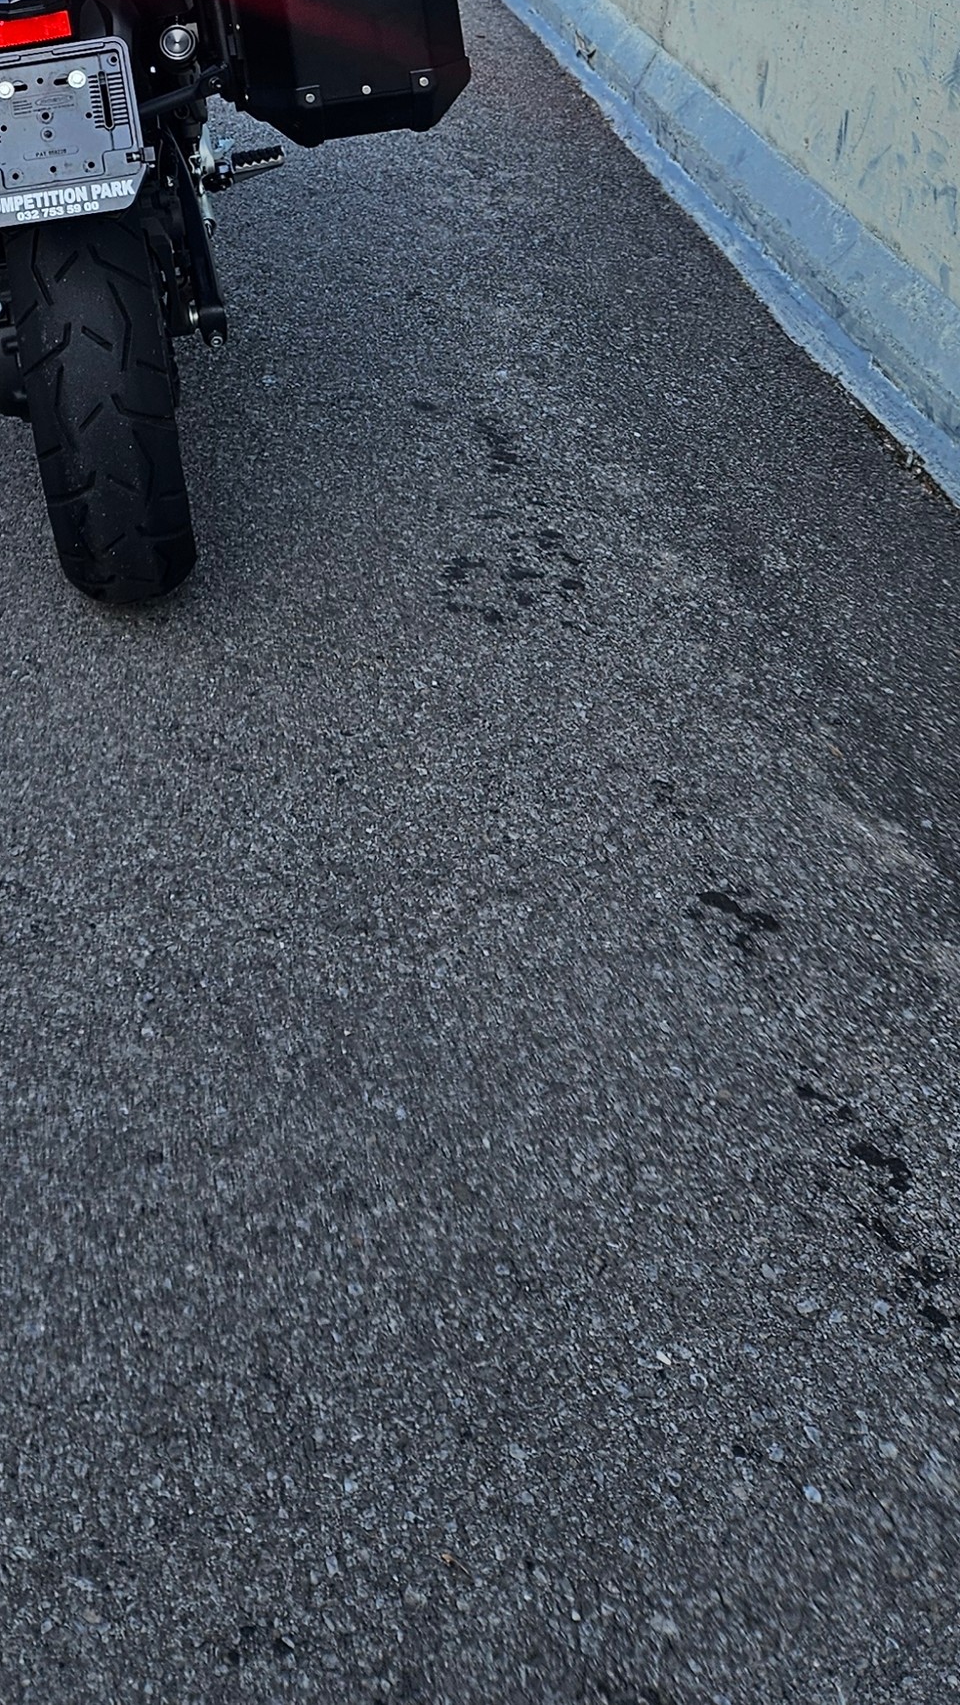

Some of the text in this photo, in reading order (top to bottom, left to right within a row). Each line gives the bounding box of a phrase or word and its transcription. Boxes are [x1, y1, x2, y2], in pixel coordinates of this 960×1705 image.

[91, 179, 135, 200] PARK
[17, 201, 100, 221] 032 753 59 00
